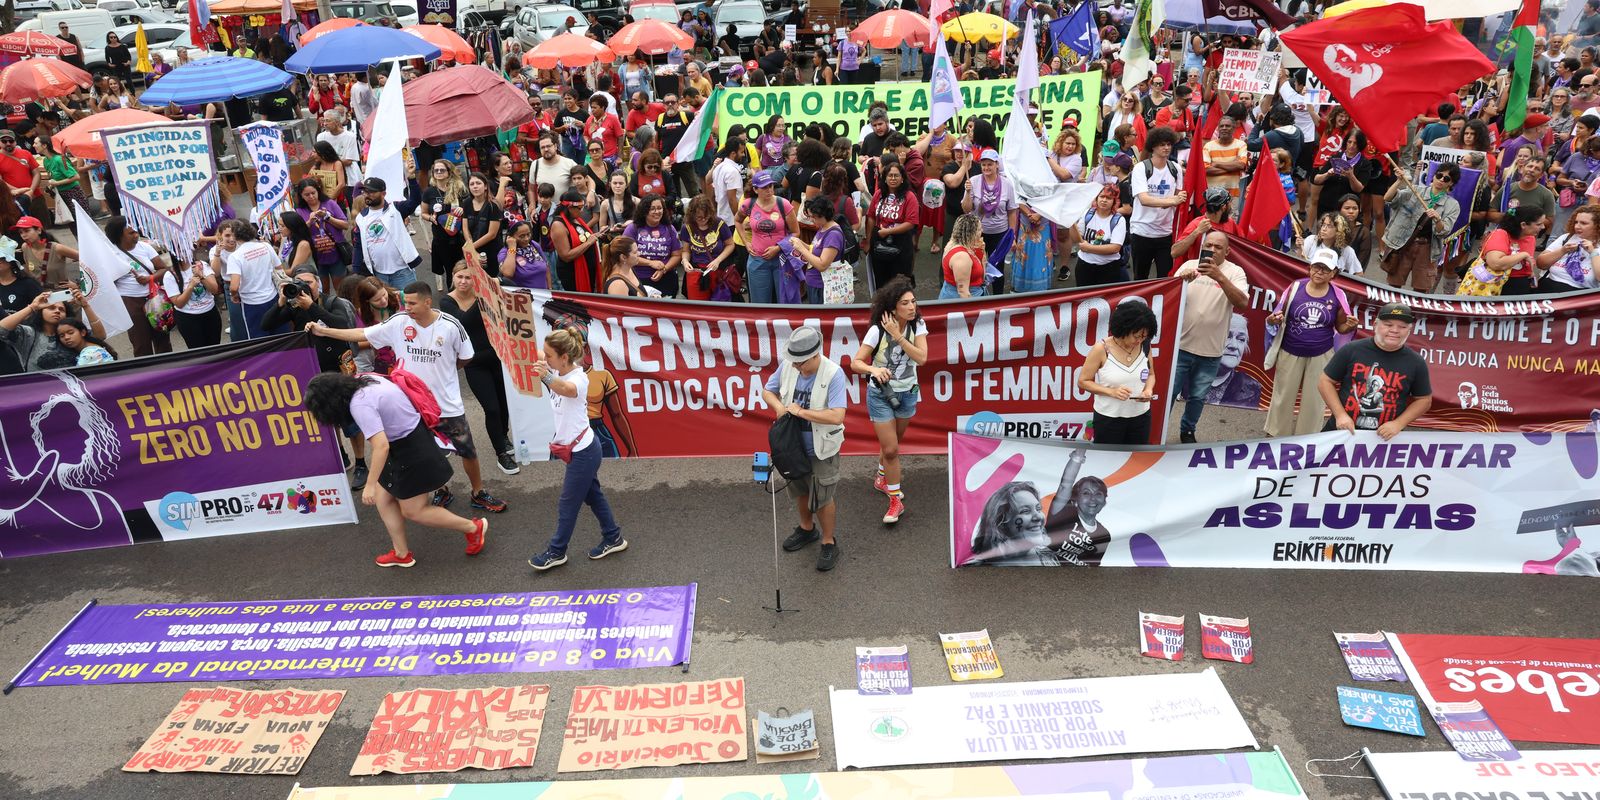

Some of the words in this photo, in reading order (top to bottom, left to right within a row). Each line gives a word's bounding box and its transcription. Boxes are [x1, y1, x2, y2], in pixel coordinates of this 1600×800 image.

[1225, 59, 1257, 71] TEMPO
[727, 92, 791, 117] COM
[802, 92, 823, 115] O
[834, 87, 874, 113] IRÃ
[886, 90, 900, 111] E
[909, 88, 928, 111] A
[116, 130, 201, 147] ATINGIDAS
[113, 149, 136, 162] EM
[139, 145, 177, 157] LUTA
[179, 143, 209, 155] POR
[127, 159, 196, 175] DIREITOS
[125, 171, 207, 191] SOBERANIA
[150, 191, 159, 201] E
[161, 185, 184, 199] PAZ
[1366, 285, 1454, 312] MULHERES
[1461, 301, 1498, 315] NAS
[1503, 299, 1555, 315] RUAS
[947, 294, 1164, 365] MENO!
[1444, 319, 1458, 338] A
[1468, 320, 1529, 343] FOME
[1541, 318, 1555, 344] E
[1565, 318, 1580, 345] O
[407, 345, 442, 358] Emirates
[1420, 348, 1499, 369] DITADURA
[1507, 355, 1564, 373] NUNCA
[117, 370, 303, 429] FEMINICÍDIO
[624, 366, 769, 418] EDUCAÇÃ
[934, 370, 954, 402] O
[1481, 397, 1508, 406] Santos
[131, 424, 212, 465] ZERO
[216, 416, 263, 453] NO
[266, 411, 322, 447] DF!!
[1042, 431, 1052, 439] DF
[1054, 422, 1084, 440] 47
[1187, 447, 1218, 469] A
[1225, 442, 1517, 471] PARLAMENTAR
[1253, 475, 1298, 500] DE
[1309, 473, 1432, 500] TODAS
[244, 504, 255, 513] DF
[257, 492, 285, 511] 47
[1203, 502, 1283, 529] AS
[1290, 502, 1477, 531] LUTAS
[1273, 541, 1326, 563] ERIKA
[1330, 542, 1394, 564] KOKAY
[401, 600, 413, 609] e
[418, 596, 524, 610] representa
[530, 593, 622, 606] SINTFUB
[627, 592, 643, 603] O
[135, 605, 239, 619] mulheres!
[242, 604, 278, 615] das
[281, 603, 319, 615] luta
[325, 604, 338, 612] a
[343, 600, 397, 612] apoia
[357, 617, 390, 631] luta
[393, 618, 416, 629] em
[418, 617, 429, 628] e
[430, 614, 493, 628] unidade
[496, 614, 520, 626] em
[521, 611, 588, 626] Sigamos
[167, 622, 256, 637] democracia.
[257, 623, 270, 634] e
[274, 620, 329, 634] direitos
[331, 620, 354, 633] por
[601, 624, 674, 639] Mulheres
[339, 635, 360, 648] de
[362, 631, 463, 647] Universidade
[464, 631, 483, 643] da
[487, 626, 598, 643] trabalhadoras
[1166, 636, 1182, 645] POR
[944, 643, 992, 655] DEMOCRACIA
[1232, 638, 1250, 648] POR
[429, 650, 517, 667] março,
[524, 648, 556, 663] de
[566, 648, 580, 663] 8
[591, 648, 606, 659] o
[616, 646, 673, 662] Viva
[972, 650, 996, 663] PELA
[152, 661, 189, 675] da
[190, 655, 369, 678] internacional
[374, 655, 418, 671] Dia
[951, 661, 998, 674] MULHERES
[1528, 659, 1540, 667] de
[38, 662, 149, 682] Mulher!
[889, 670, 908, 679] PELO
[615, 679, 744, 712] REFORMA
[1443, 667, 1600, 713] ebes
[1014, 699, 1104, 718] SOBERANIA
[1388, 697, 1415, 708] DAS
[505, 709, 543, 723] nas
[964, 706, 993, 721] PAZ
[1002, 705, 1009, 719] E
[1383, 706, 1416, 718] VIDA
[167, 721, 187, 730] DE
[193, 718, 250, 734] FORMA
[267, 719, 313, 734] NOVA
[318, 720, 328, 729] A
[1069, 716, 1098, 732] POR
[1379, 714, 1416, 726] PELA
[1382, 722, 1420, 734] LUTA
[455, 727, 539, 747] Sendo
[776, 733, 796, 743] DE
[1014, 737, 1038, 750] EM
[1044, 729, 1127, 750] ATINGIDAS
[251, 744, 280, 755] DOS
[718, 739, 740, 759] O
[780, 741, 812, 752] BRB
[965, 738, 1008, 754] LUTA
[125, 751, 208, 770] GUARDA
[220, 756, 306, 774] RETIRAR
[400, 747, 534, 772] MULHERES
[1475, 762, 1512, 777] DF
